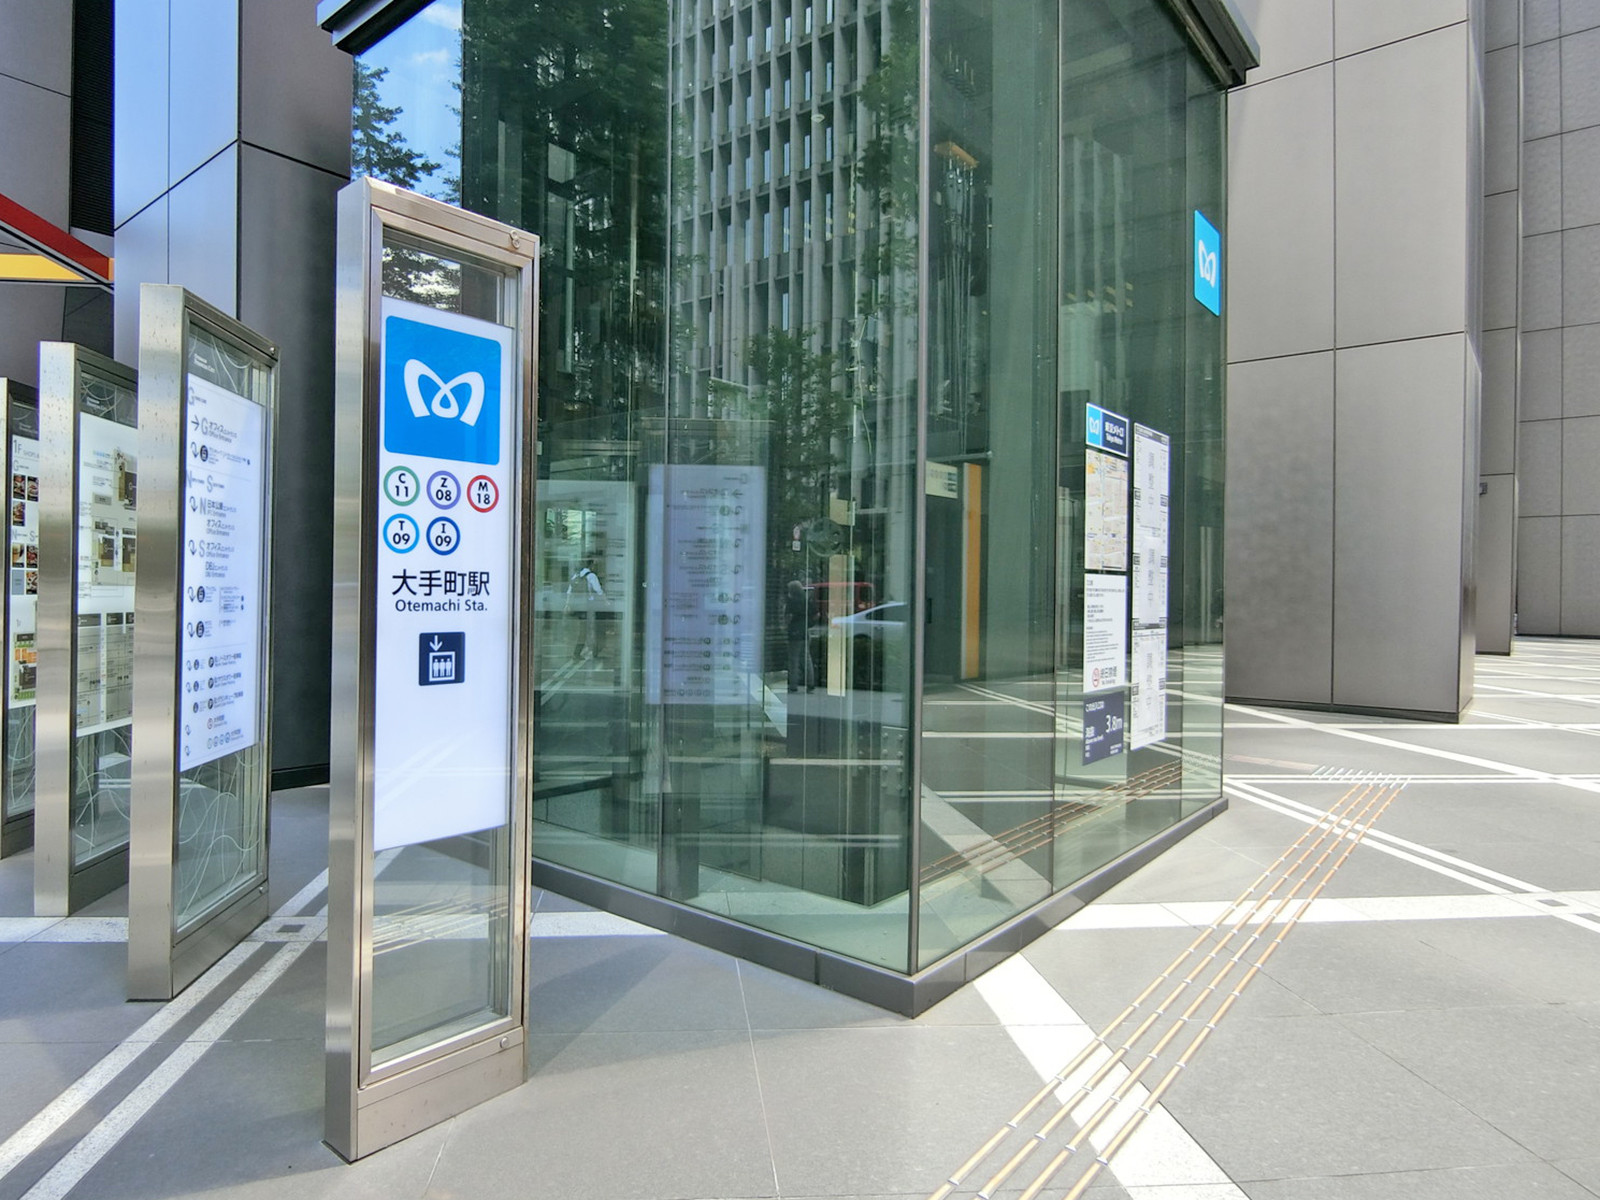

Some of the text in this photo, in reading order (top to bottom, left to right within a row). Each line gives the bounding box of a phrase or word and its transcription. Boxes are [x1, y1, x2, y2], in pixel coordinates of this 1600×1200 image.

[398, 473, 406, 484] C
[440, 477, 448, 488] Z
[395, 485, 409, 498] 11
[478, 481, 489, 492] M
[435, 489, 452, 502] 08
[476, 493, 491, 505] 18
[398, 520, 405, 531] T
[441, 523, 446, 534] I
[392, 532, 410, 545] 09
[435, 535, 452, 547] 09
[392, 568, 490, 597] 大手町駅
[395, 599, 488, 612] Otemachi Sta.
[1105, 714, 1123, 734] 3.8m
